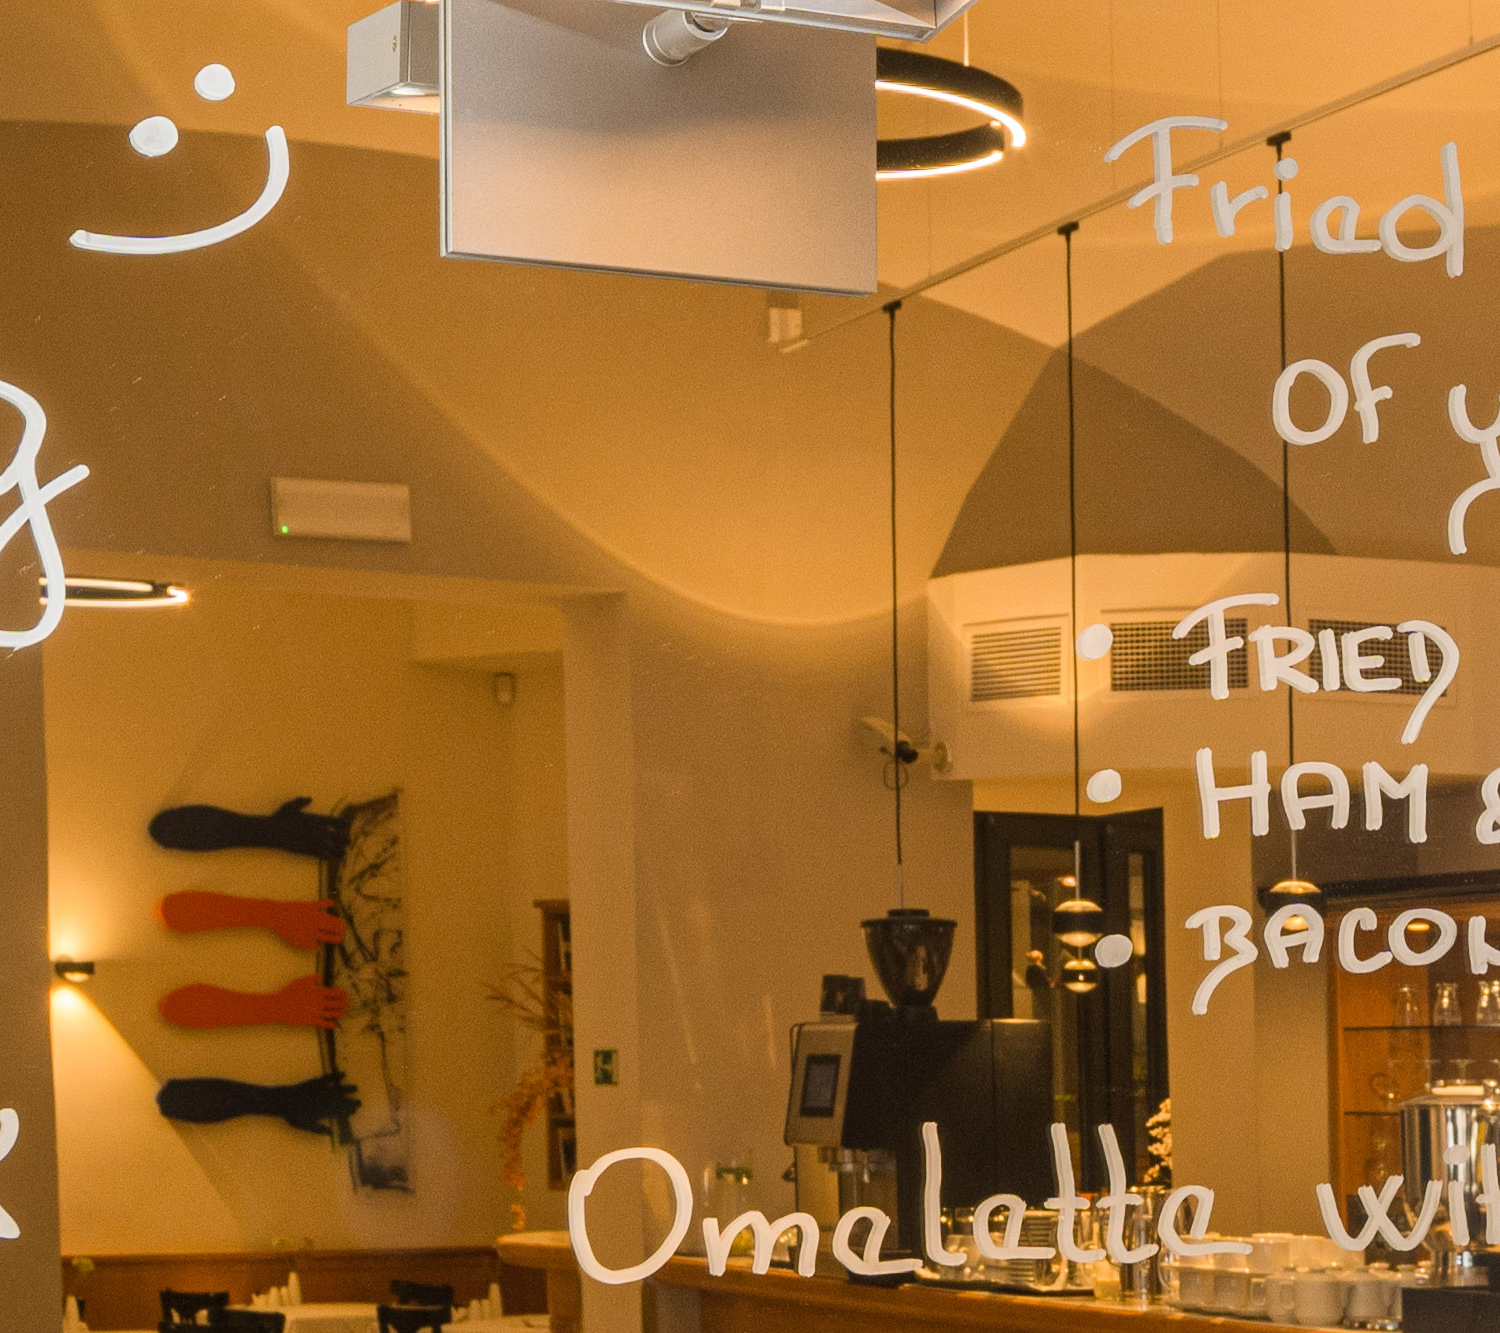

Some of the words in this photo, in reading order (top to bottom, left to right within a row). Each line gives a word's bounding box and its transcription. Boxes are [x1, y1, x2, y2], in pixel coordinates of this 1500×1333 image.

[1107, 115, 1465, 279] Fried
[1172, 593, 1459, 745] FRIED
[1194, 747, 1428, 844] HAM
